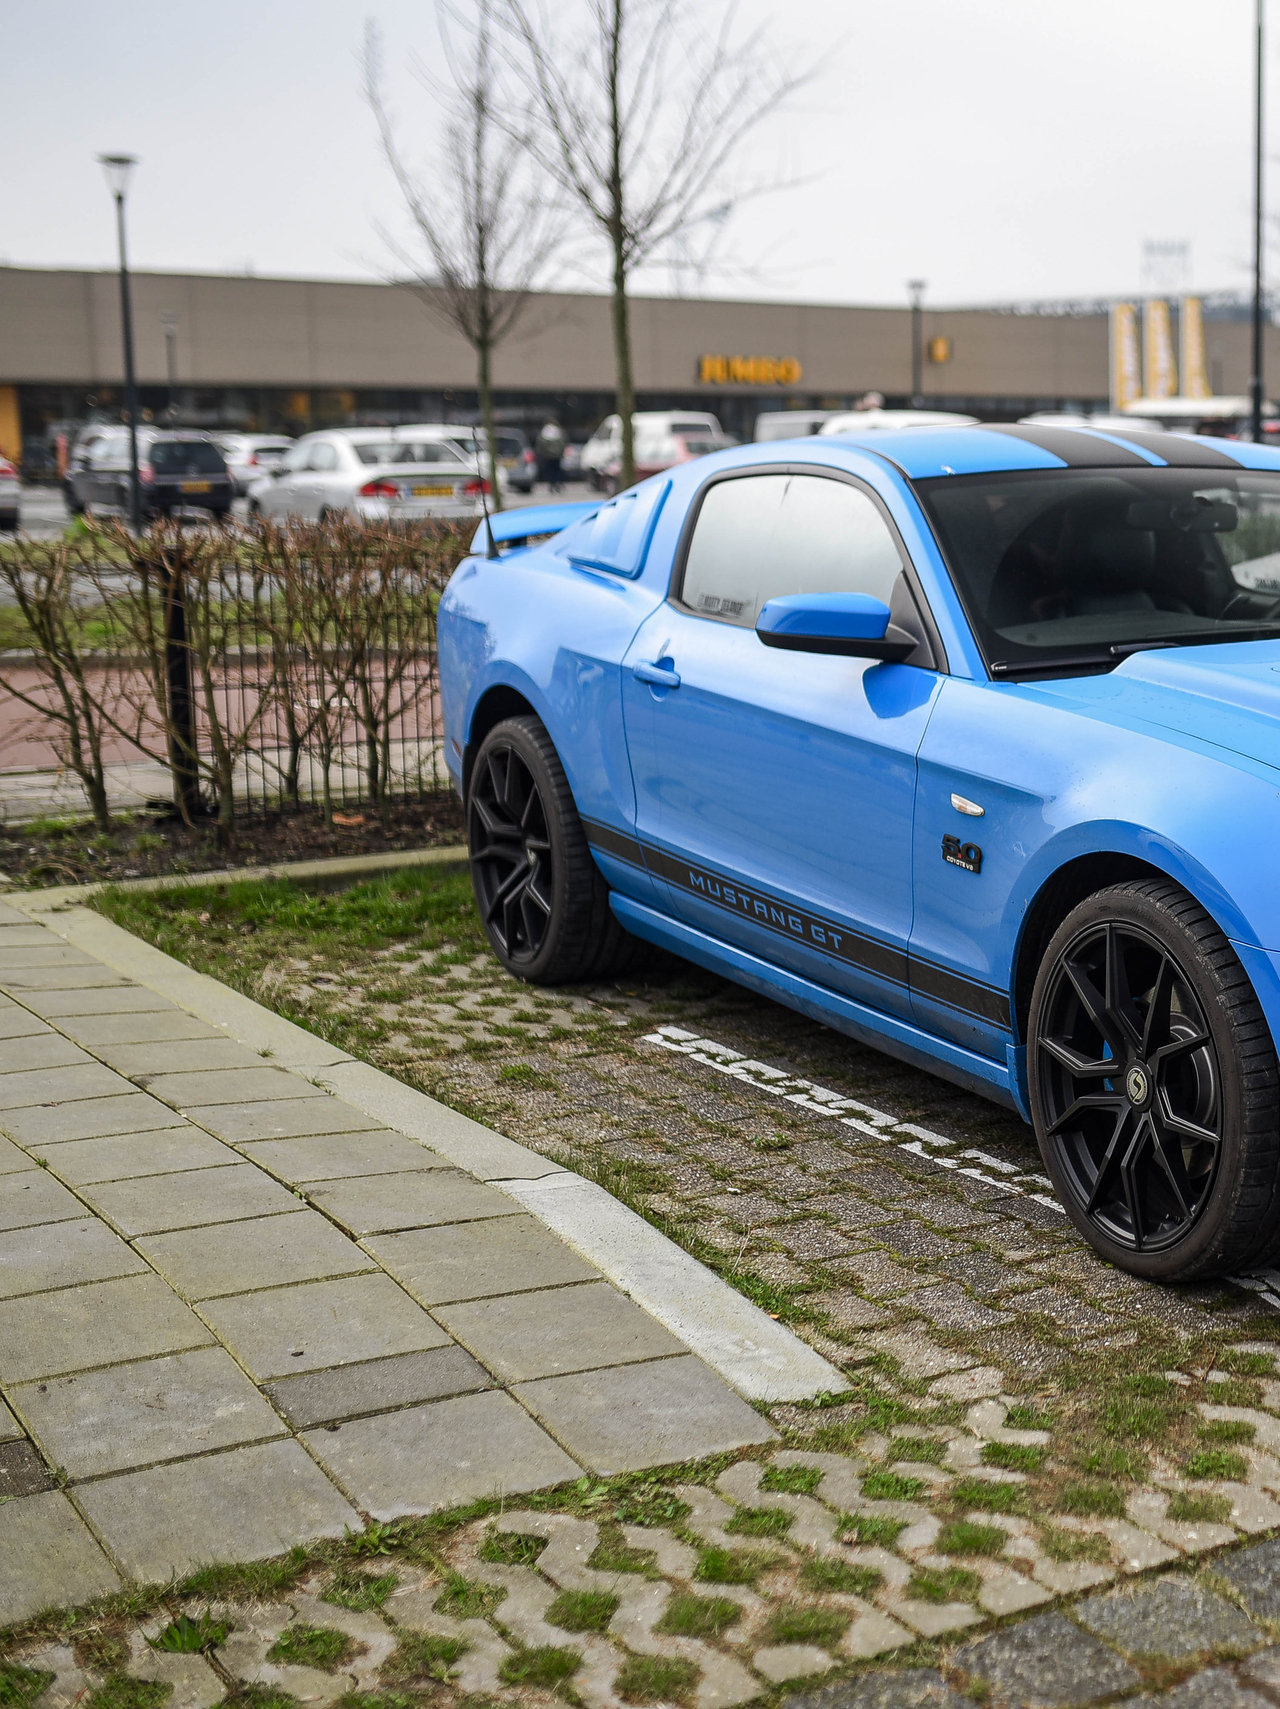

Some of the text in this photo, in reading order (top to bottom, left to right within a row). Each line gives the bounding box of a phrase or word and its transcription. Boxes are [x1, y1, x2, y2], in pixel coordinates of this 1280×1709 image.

[699, 354, 802, 385] JUMBO
[941, 833, 983, 865] 5.0
[689, 871, 842, 949] MUSTANG GT
